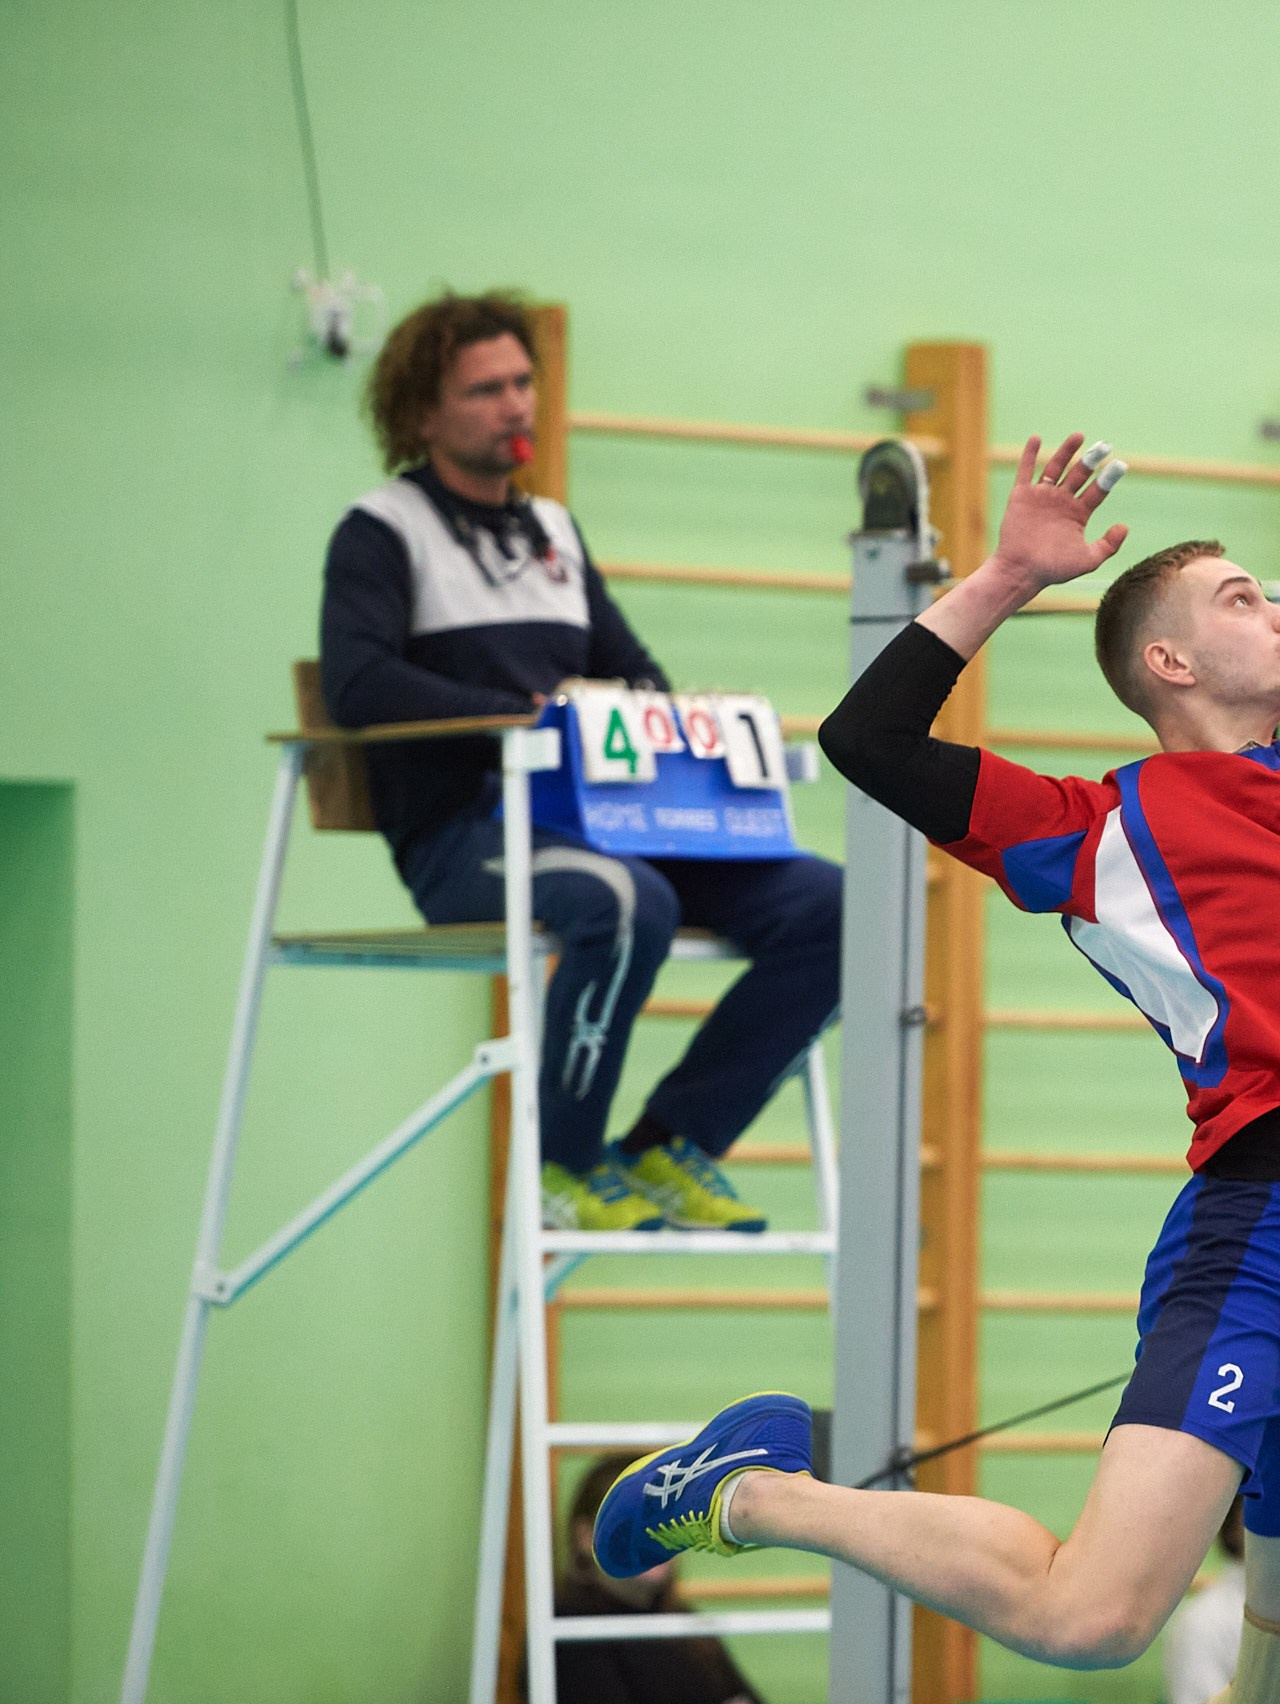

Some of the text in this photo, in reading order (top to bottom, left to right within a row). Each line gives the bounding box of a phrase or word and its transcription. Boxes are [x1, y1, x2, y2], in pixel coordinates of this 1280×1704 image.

[604, 707, 638, 774] 4
[643, 706, 674, 745] 0
[688, 710, 718, 750] 0
[1207, 1363, 1244, 1414] 2
